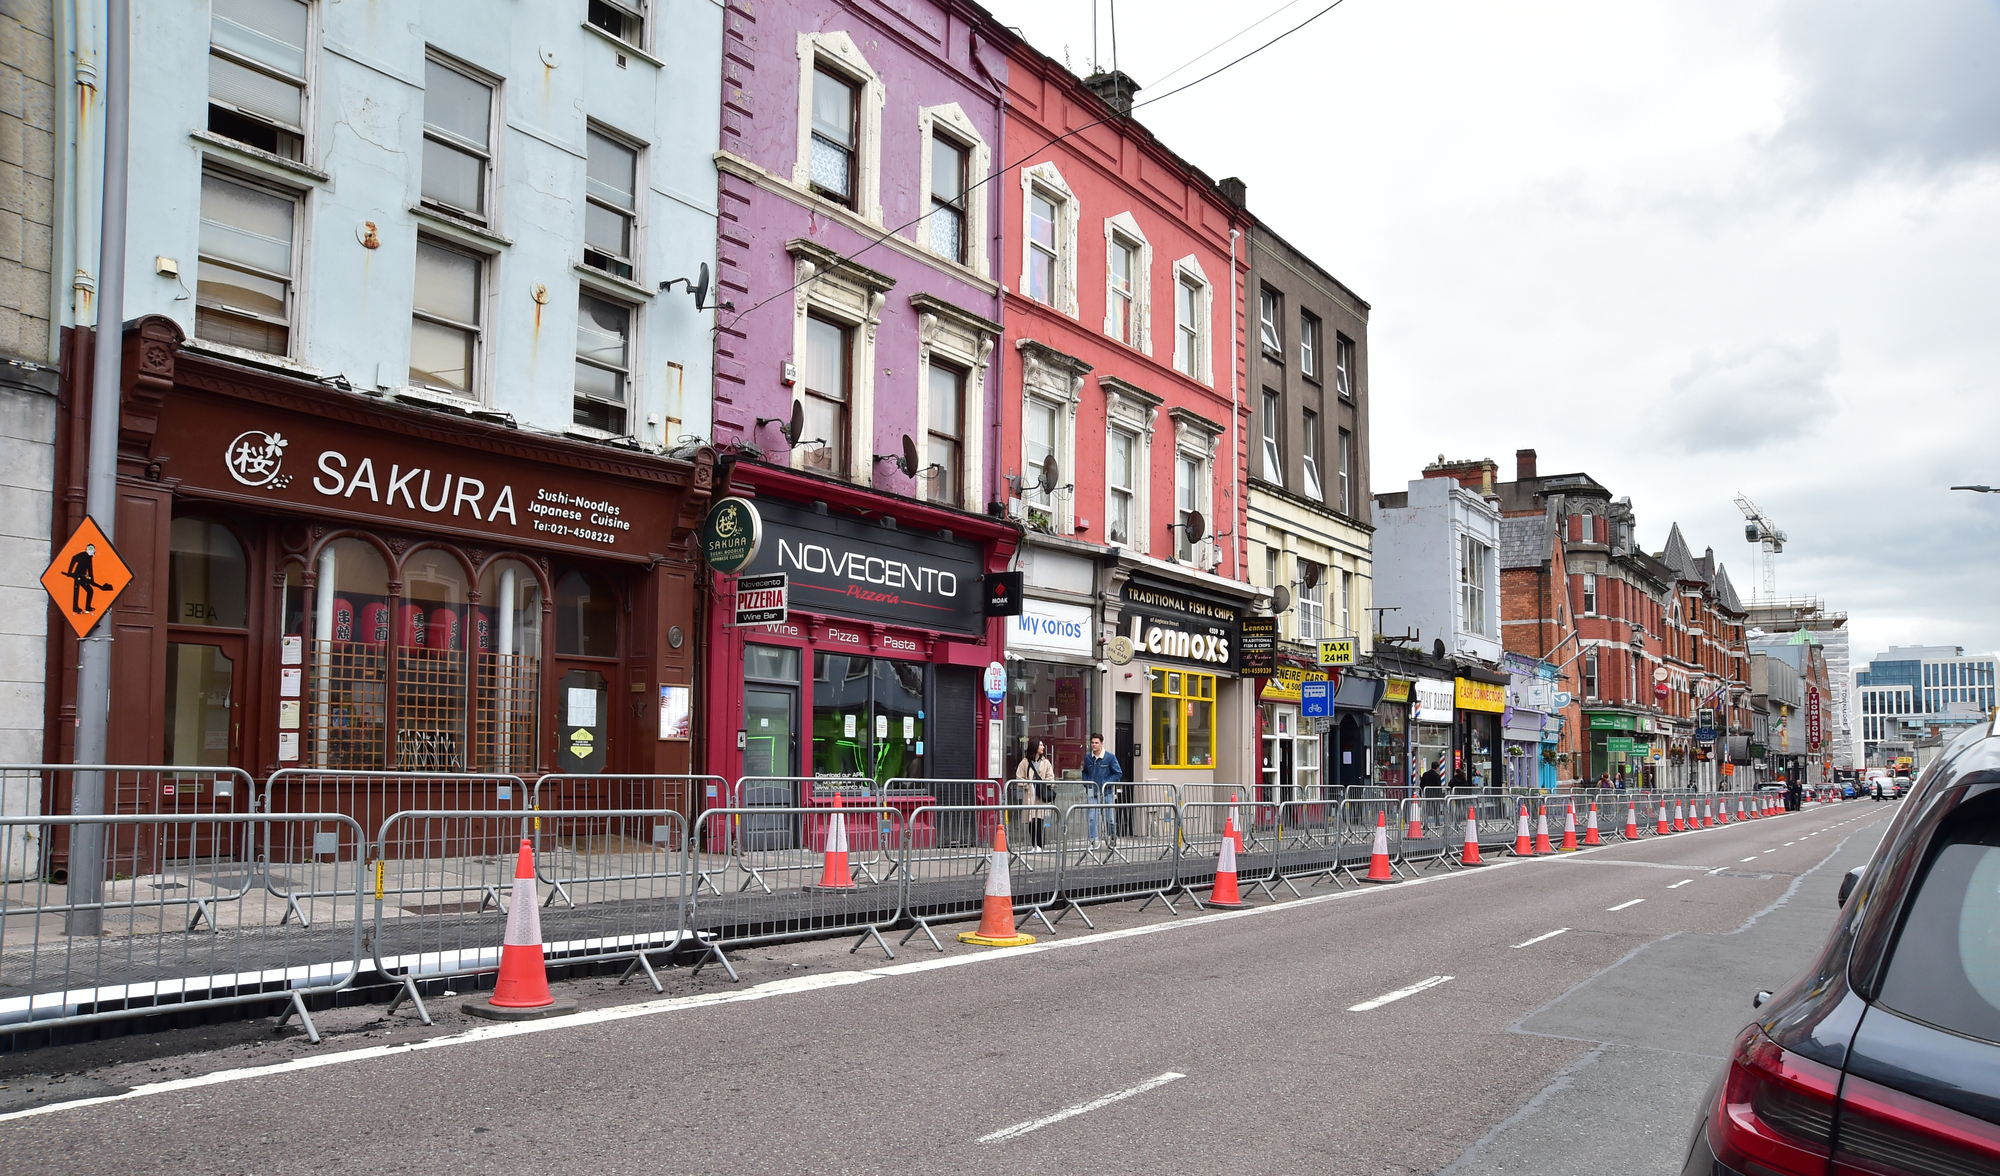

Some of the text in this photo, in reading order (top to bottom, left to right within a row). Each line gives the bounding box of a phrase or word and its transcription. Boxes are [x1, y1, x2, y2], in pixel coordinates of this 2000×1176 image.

[233, 442, 275, 475] 桜
[313, 450, 517, 525] SAKURA
[537, 488, 620, 515] Sushi-Noodles
[527, 501, 630, 531] Japanese Cuisine
[533, 520, 615, 543] Tel:021-4508228
[709, 536, 747, 550] SAKURA
[778, 538, 957, 597] NOVECENTO
[741, 579, 781, 588] Novecento
[738, 590, 783, 610] PIZZERIA
[846, 584, 900, 604] Pizzeria
[1128, 587, 1235, 622] TRADITIONAL FISH & CHIPS
[766, 623, 798, 635] Wine
[828, 628, 860, 643] Pizza
[1243, 621, 1273, 632] Lennoxs
[883, 635, 916, 650] Pasta
[1131, 615, 1229, 664] Lennoxs
[1323, 642, 1349, 651] TAXI
[990, 667, 1001, 676] LOVE
[990, 679, 1001, 690] LEE
[1433, 692, 1452, 711] BARBER
[1460, 686, 1503, 703] CASH CONNECTORS
[1811, 693, 1819, 742] THOMPSONS
